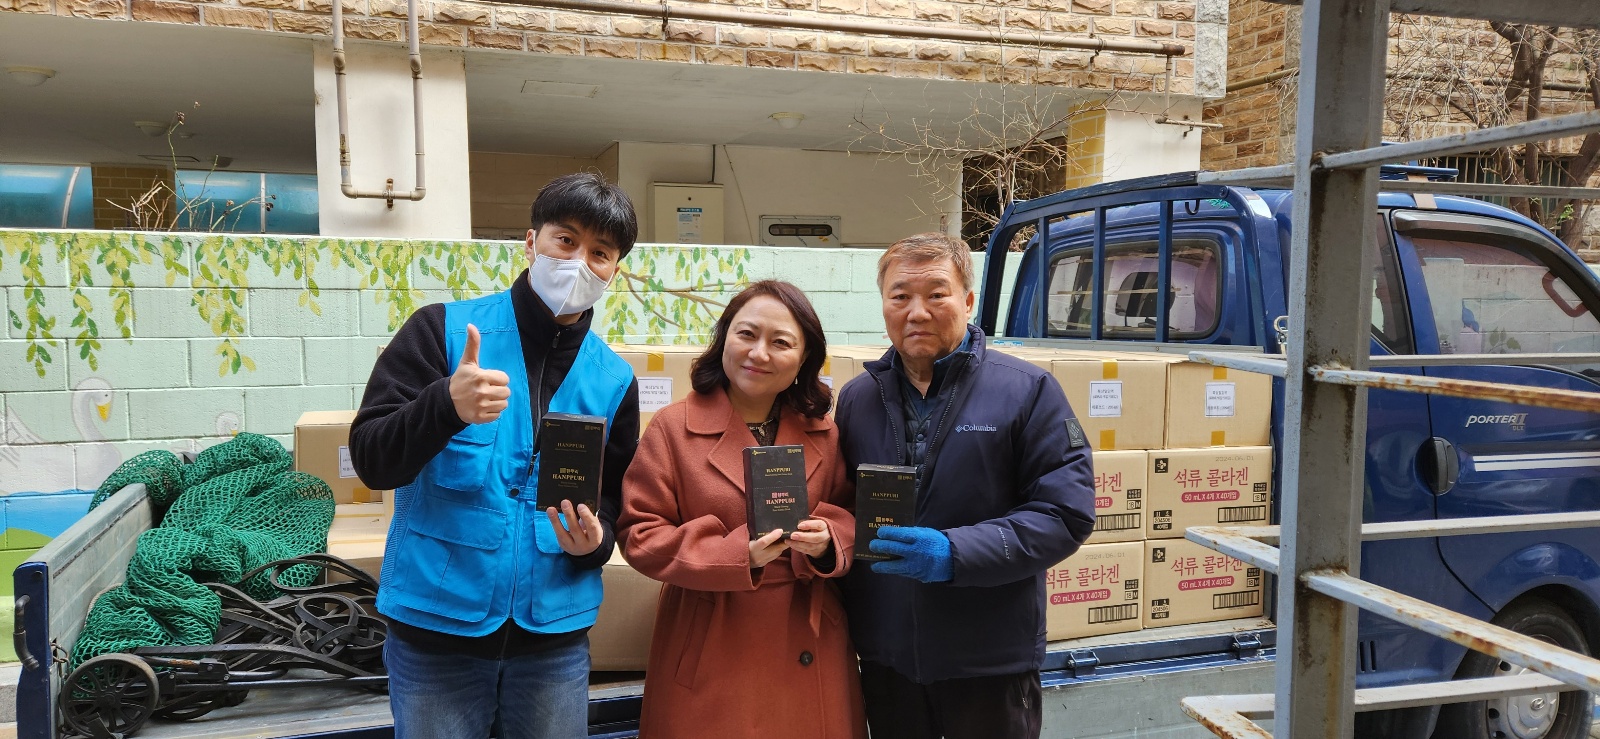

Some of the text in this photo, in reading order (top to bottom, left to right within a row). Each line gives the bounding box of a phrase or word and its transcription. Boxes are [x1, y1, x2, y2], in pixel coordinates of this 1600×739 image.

[963, 424, 997, 432] Columbia
[1465, 415, 1517, 428] PORTER
[552, 473, 585, 482] HANPPURI
[1094, 471, 1122, 493] 라겐
[1174, 466, 1249, 488] 석류 콜라겐
[1171, 556, 1199, 576] 석류
[1046, 569, 1072, 590] 석류
[1076, 564, 1119, 587] 콜라겐
